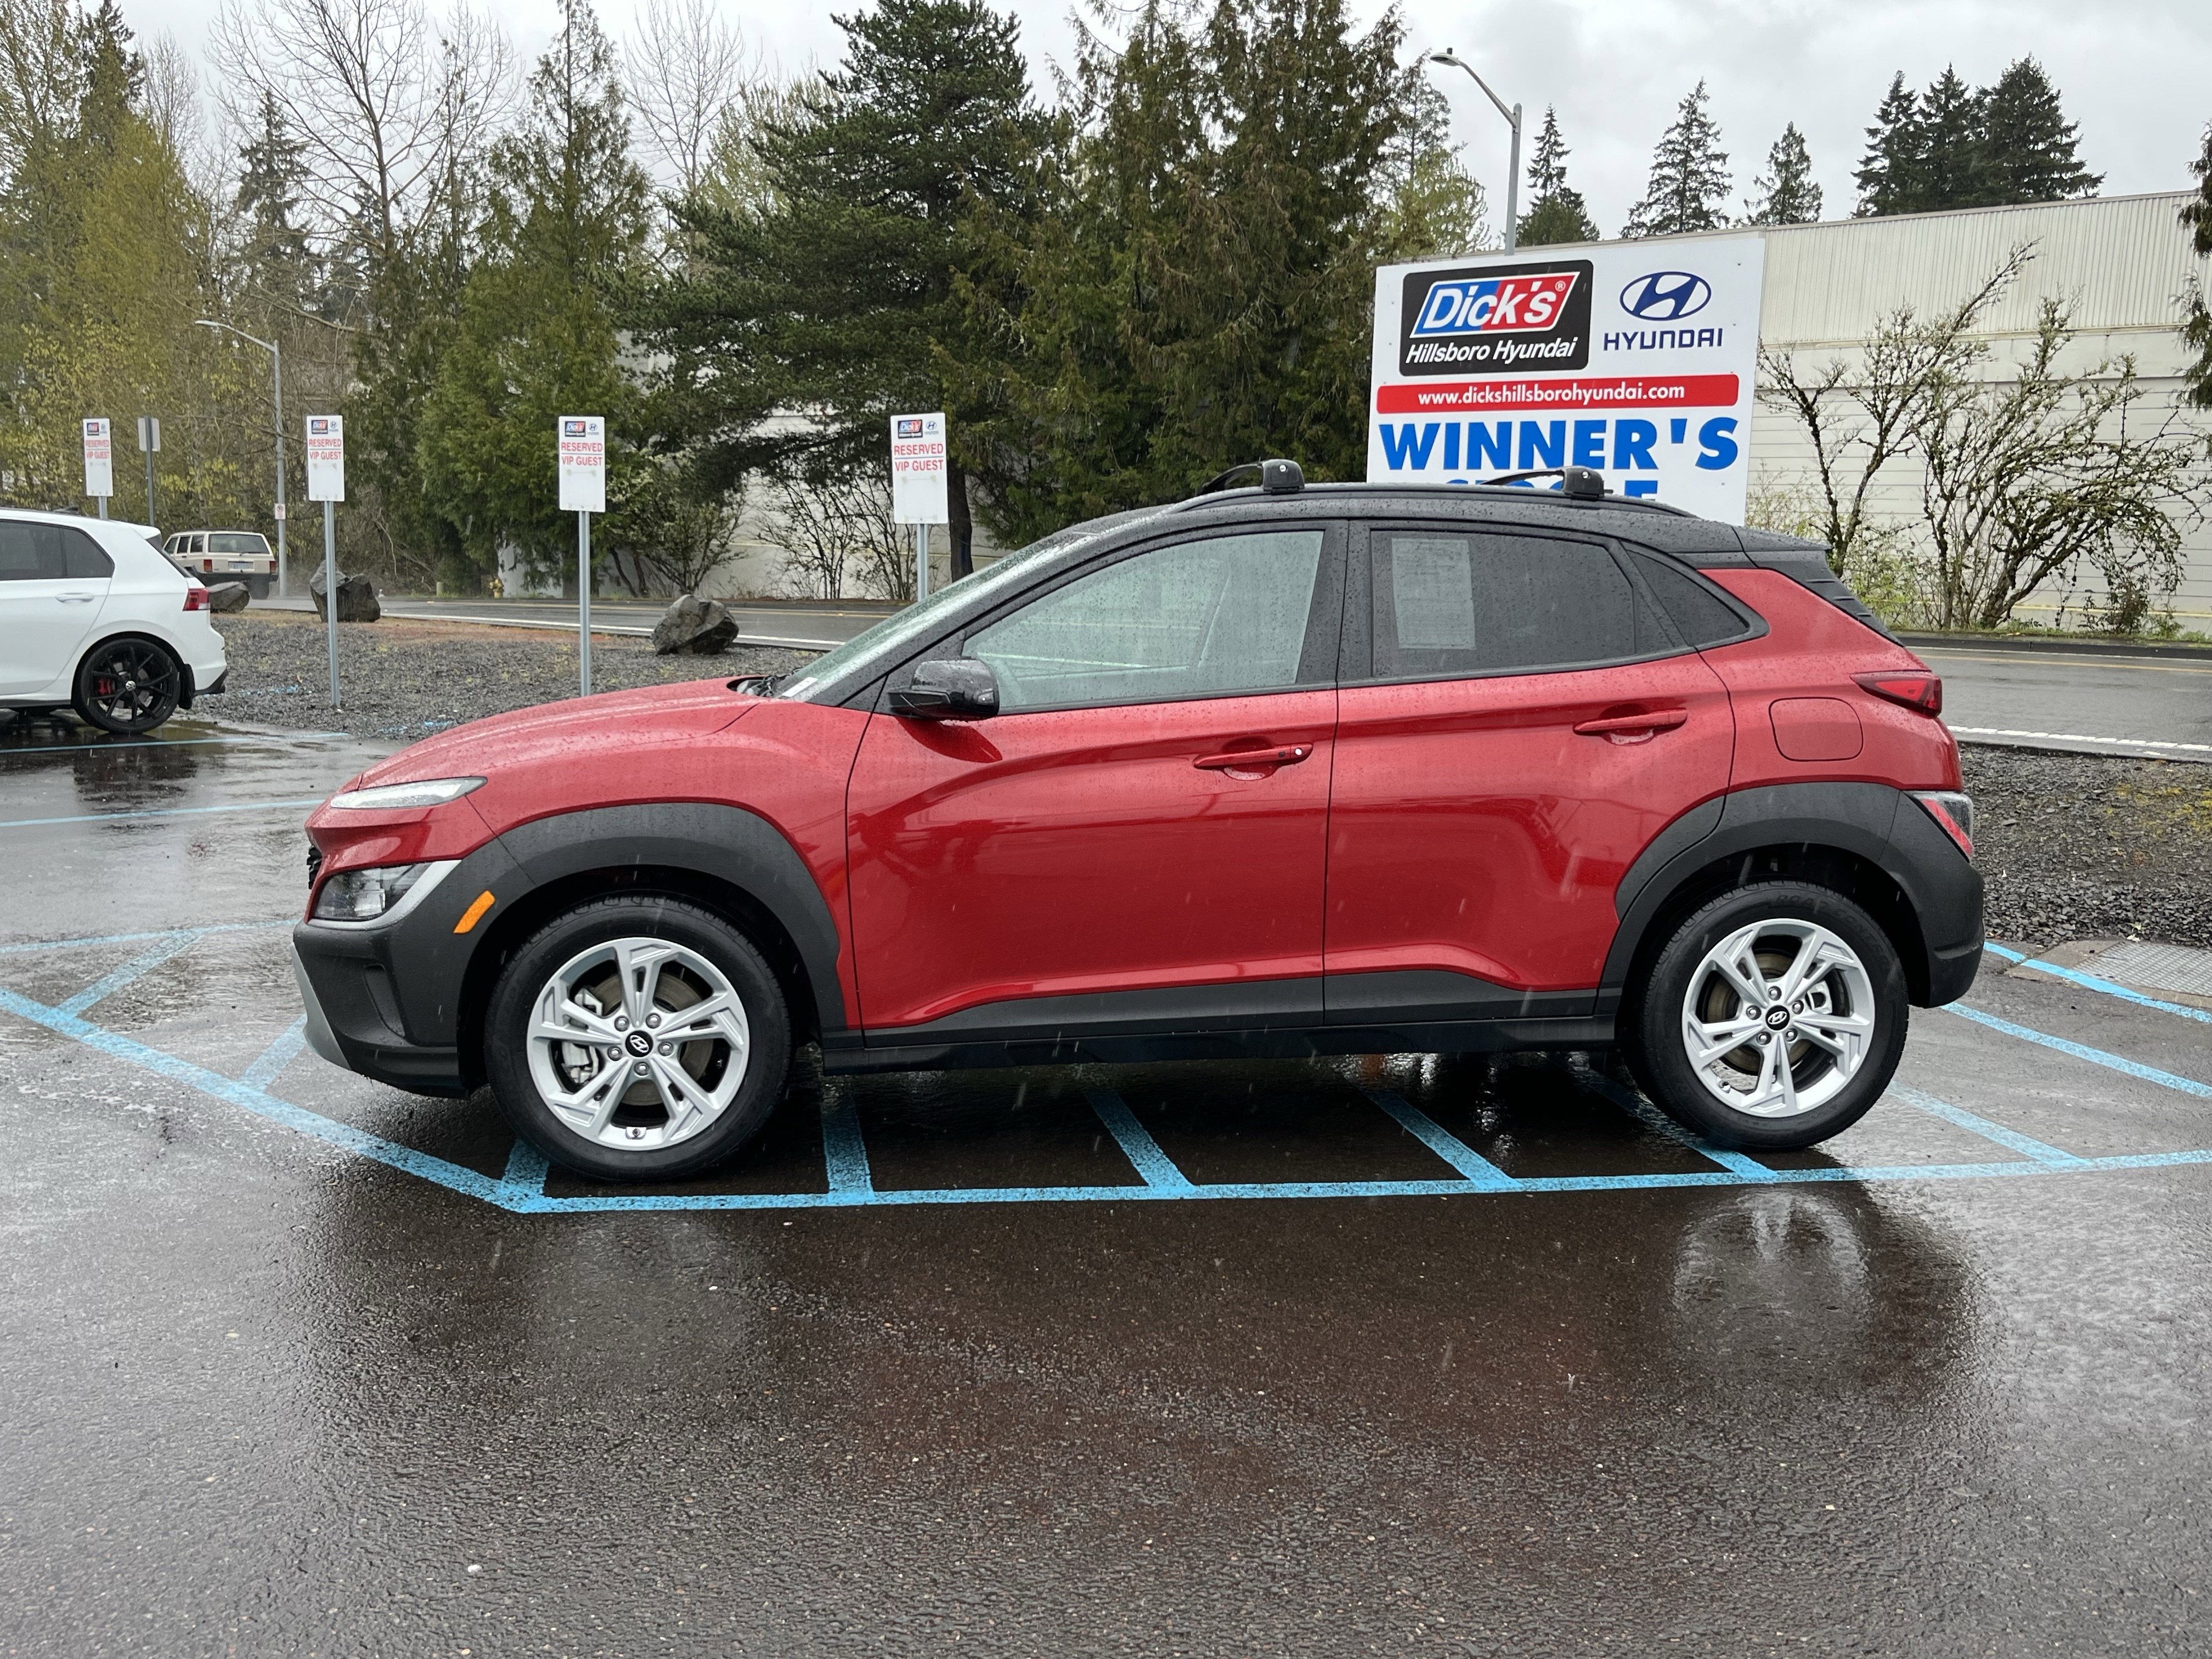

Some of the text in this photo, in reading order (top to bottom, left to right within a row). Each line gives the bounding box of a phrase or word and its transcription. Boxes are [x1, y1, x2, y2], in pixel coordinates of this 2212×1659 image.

[1604, 328, 1723, 352] HYUNDAI
[1405, 336, 1578, 364] Hillsboro Hyundai
[1418, 381, 1685, 405] www.dickshillsborohyundai.com
[309, 439, 342, 448] RESERVED
[561, 442, 603, 452] RESERVED
[894, 443, 944, 456] RESERVED
[1379, 416, 1739, 471] WINNER'S
[309, 452, 342, 460] VIP GUEST
[561, 456, 603, 466] VIP GUEST
[895, 460, 944, 472] VIP GUEST
